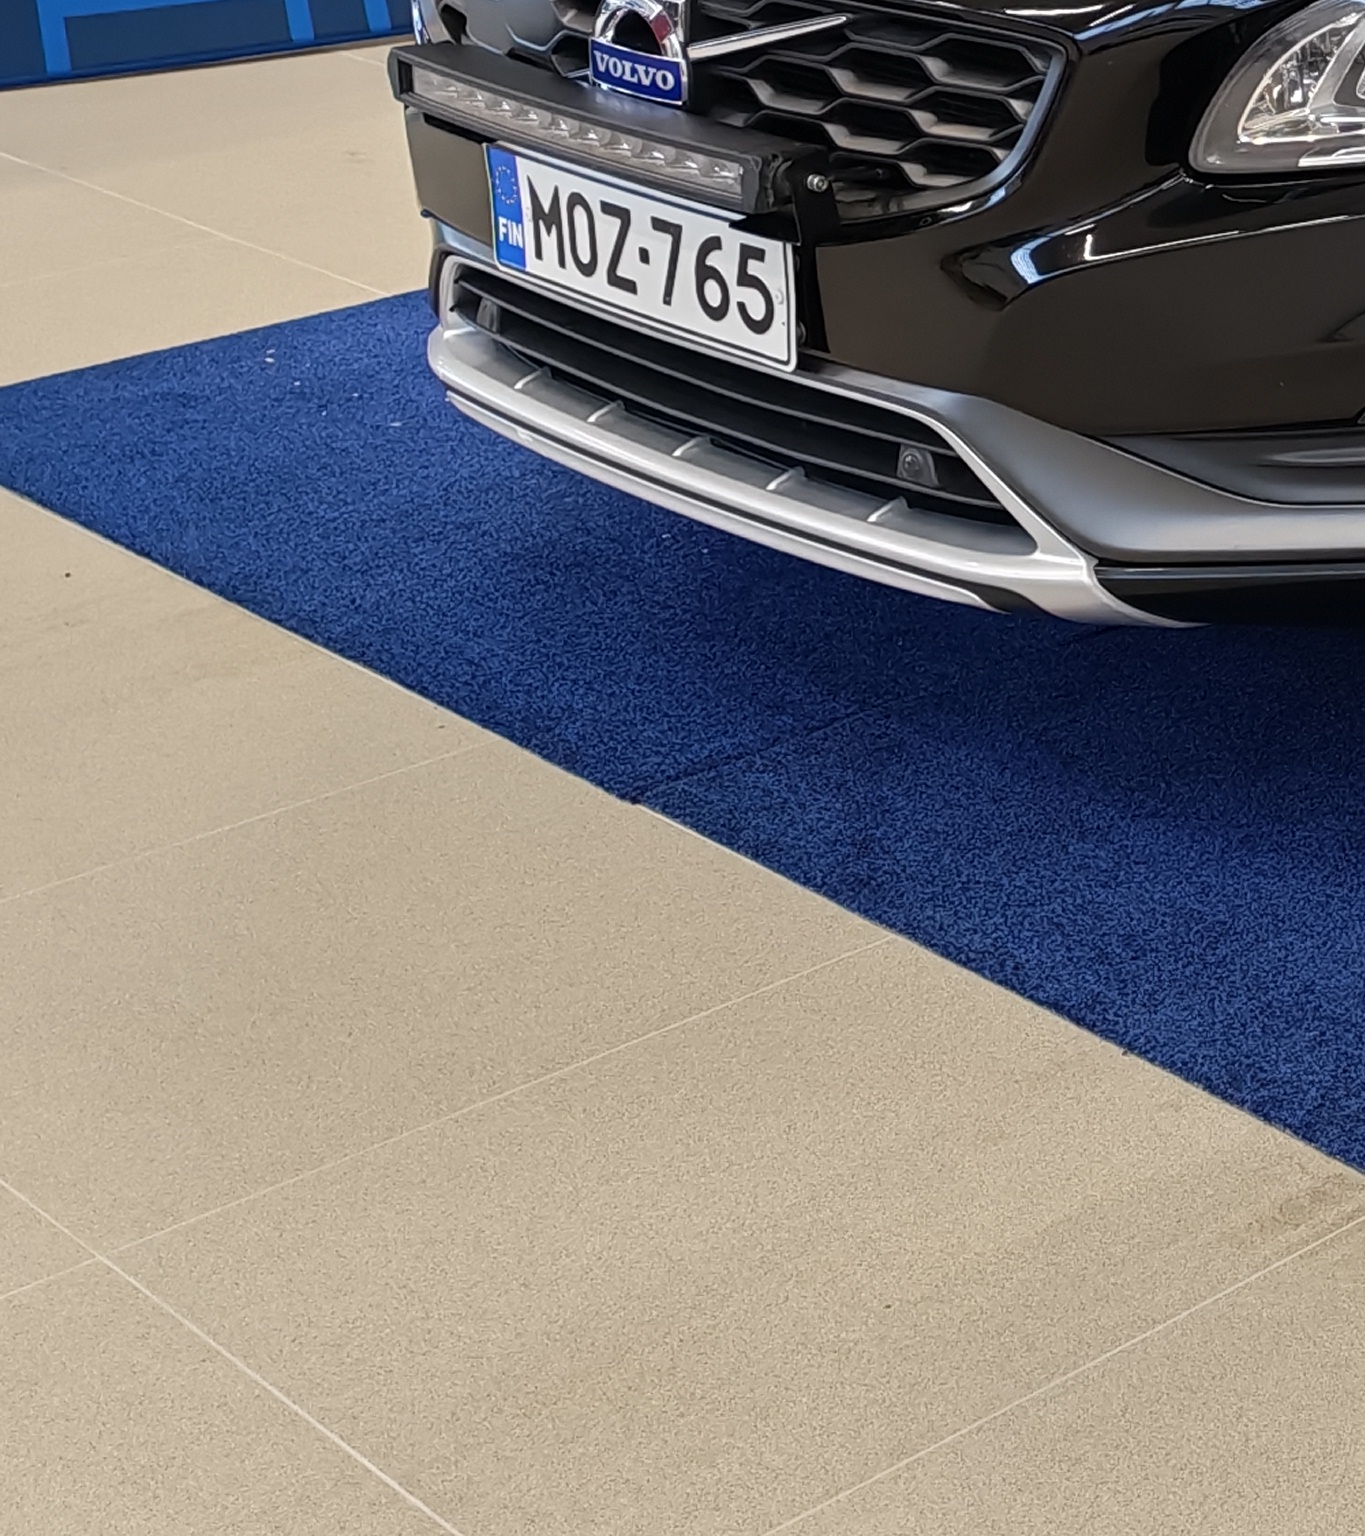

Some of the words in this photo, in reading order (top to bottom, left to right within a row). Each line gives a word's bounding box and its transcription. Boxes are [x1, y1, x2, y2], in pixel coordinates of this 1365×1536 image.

[593, 50, 675, 91] VOLVO
[498, 216, 523, 249] FIN
[526, 174, 775, 336] MOZ-765
